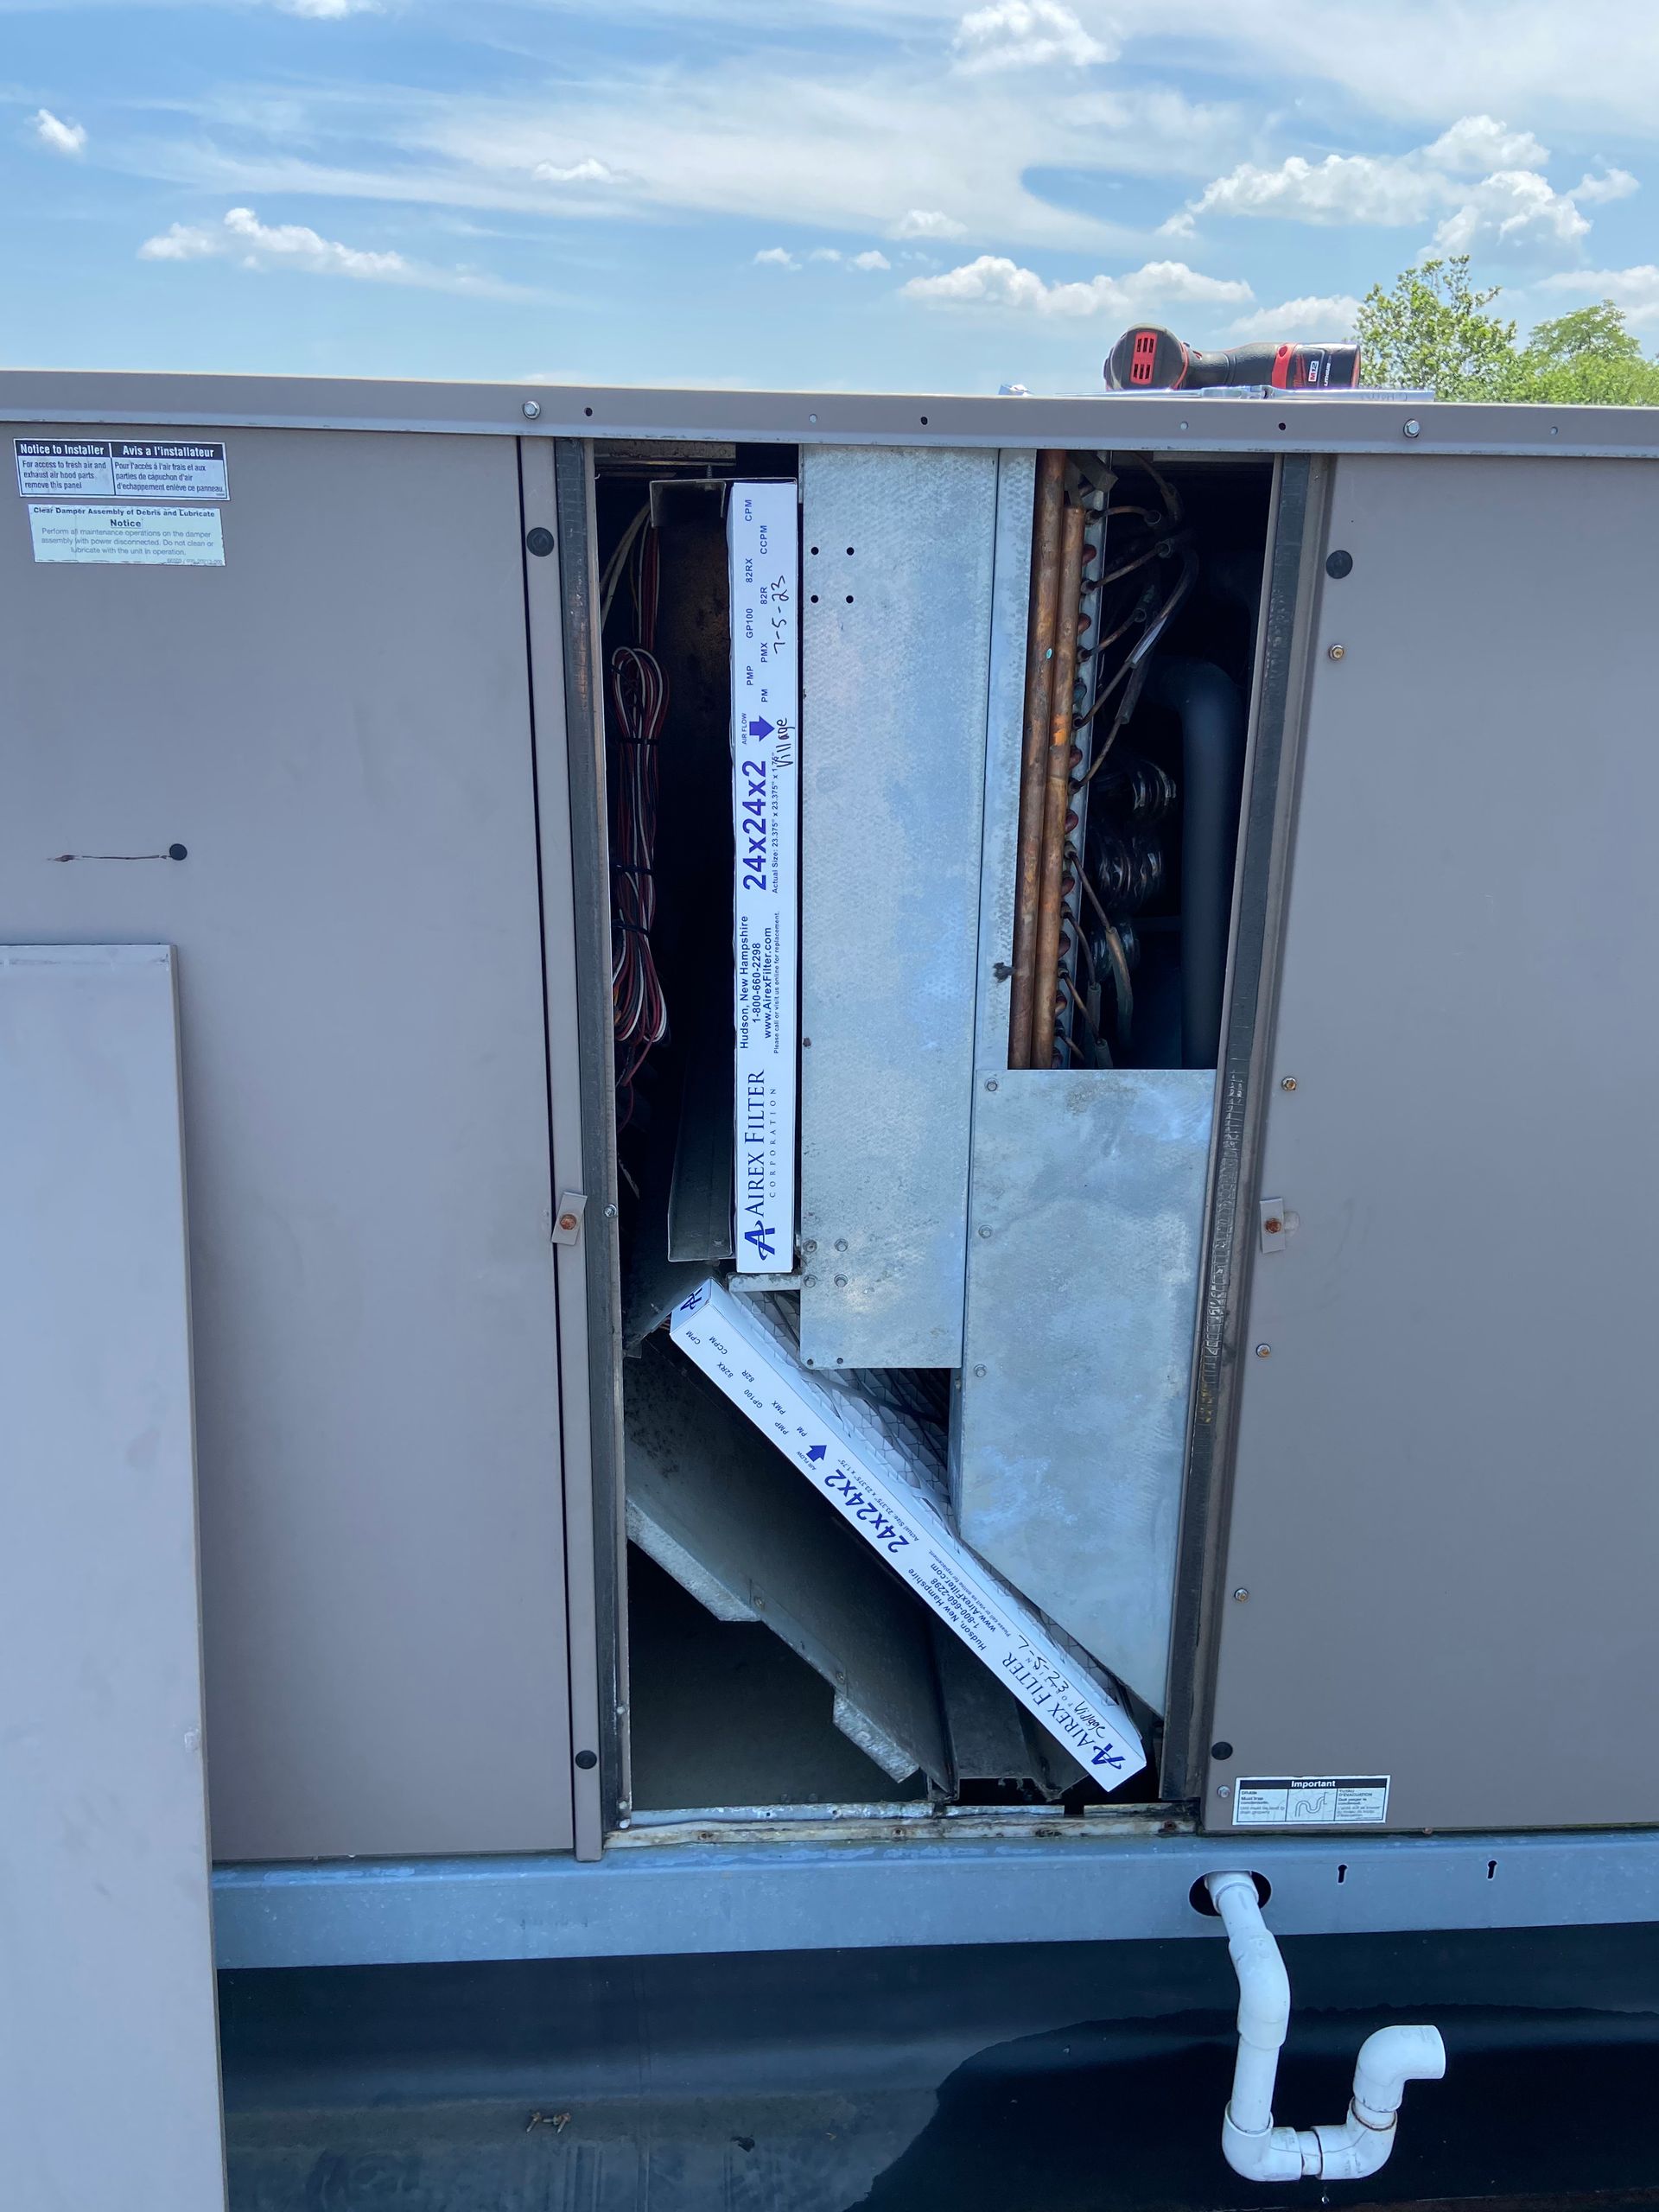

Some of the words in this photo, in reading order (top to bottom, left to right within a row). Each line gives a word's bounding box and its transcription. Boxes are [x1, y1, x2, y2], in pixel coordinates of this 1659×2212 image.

[1309, 361, 1319, 381] M12
[20, 444, 50, 454] Notice
[52, 444, 62, 454] to
[64, 444, 104, 455] Installer
[123, 446, 143, 455] Avis
[145, 448, 152, 456] a
[154, 446, 214, 458] l'installateur
[114, 461, 130, 470] Pour
[147, 474, 178, 482] capuchon
[110, 518, 142, 527] Notice
[771, 574, 788, 654] 7-5-23
[760, 689, 767, 702] PM
[774, 717, 795, 767] Village
[741, 760, 766, 890] 24x24x2
[740, 915, 750, 974] Hampshire
[740, 978, 748, 1001] New
[752, 942, 760, 1022] 1-800-660-2298
[762, 926, 771, 1038] www.AirexFilter.com
[740, 1004, 750, 1048] Hudson,
[745, 1068, 764, 1144] FILTER
[744, 1152, 764, 1217] AIREX
[686, 1331, 701, 1344] CPM
[709, 1336, 728, 1355] CCPM
[717, 1362, 734, 1378] 82RX
[741, 1370, 755, 1382] 82R
[744, 1389, 763, 1408] GP100
[772, 1400, 786, 1415] PMX
[774, 1422, 789, 1435] PMP
[797, 1426, 807, 1437] PM
[796, 1452, 809, 1464] FLOW
[807, 1462, 817, 1471] AIR
[824, 1469, 910, 1554] 24x24x2
[893, 1516, 905, 1527] Size:
[903, 1526, 919, 1541] Actual
[908, 1569, 944, 1606] Hampshire
[959, 1581, 972, 1595] online
[930, 1563, 996, 1632] www.AirexFilter.com
[930, 1578, 980, 1628] 1-800-660-2298
[976, 1600, 986, 1610] visit
[943, 1605, 959, 1622] New
[988, 1614, 998, 1623] call
[960, 1621, 987, 1650] Hudson,
[997, 1623, 1011, 1637] Please
[1002, 1652, 1052, 1706] FILTER
[1047, 1702, 1095, 1747] AIREX
[1291, 1780, 1336, 1789] Important
